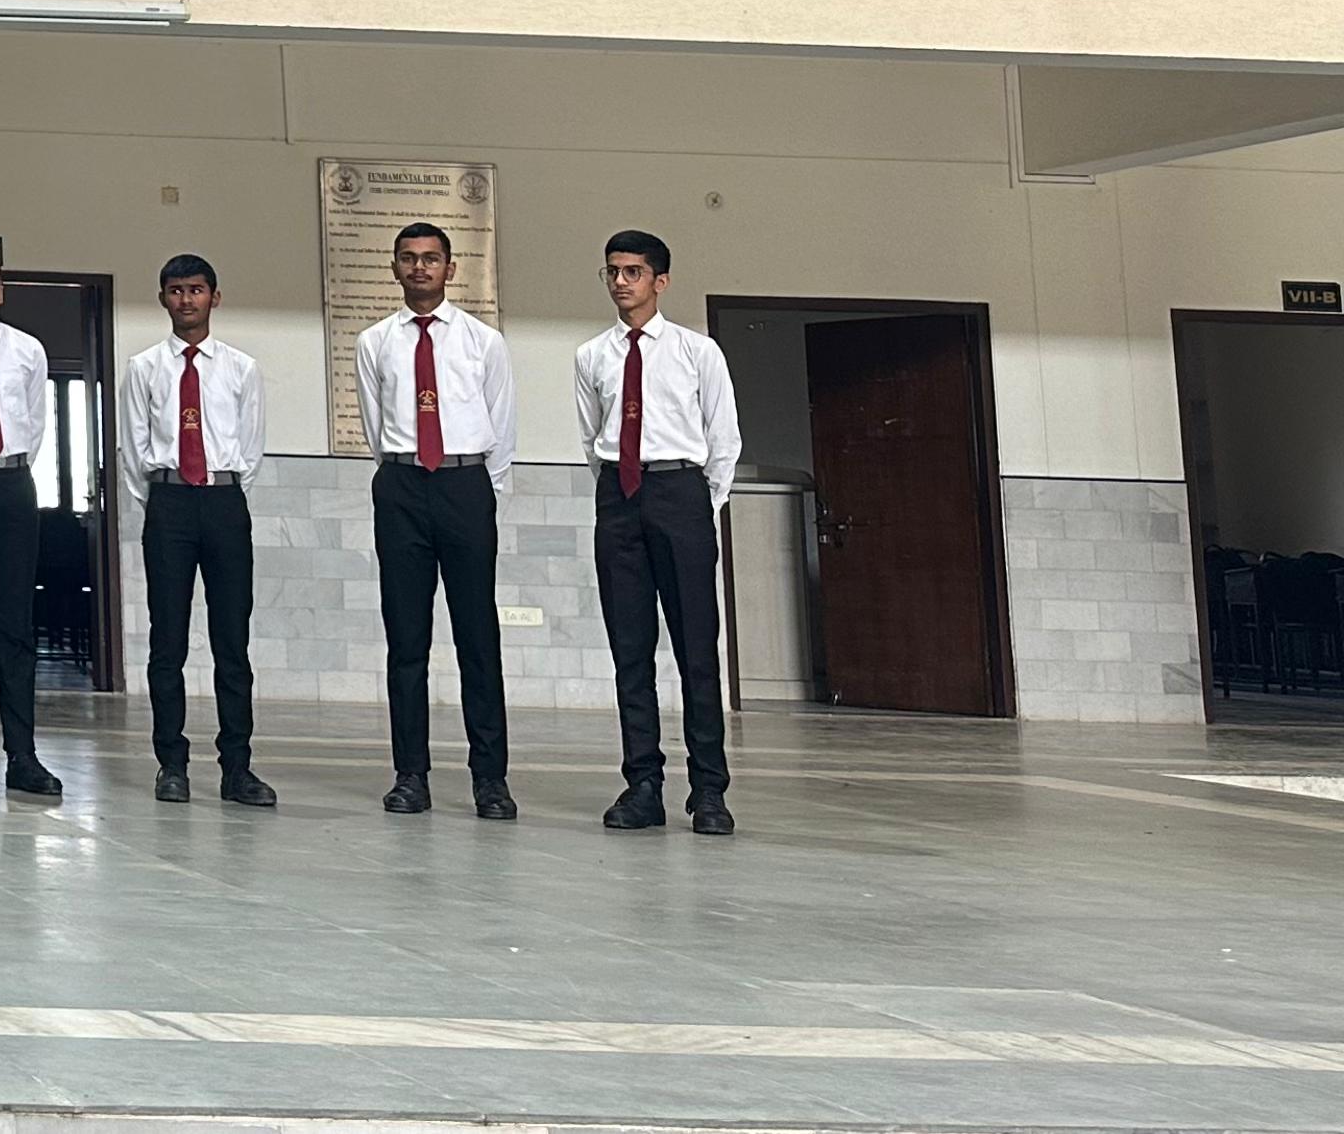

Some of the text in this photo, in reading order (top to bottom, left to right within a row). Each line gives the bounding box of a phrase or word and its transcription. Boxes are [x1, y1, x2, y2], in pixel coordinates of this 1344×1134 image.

[368, 172, 450, 184] FUNDAMENTAL DUTIES
[1287, 290, 1337, 303] VII-B
